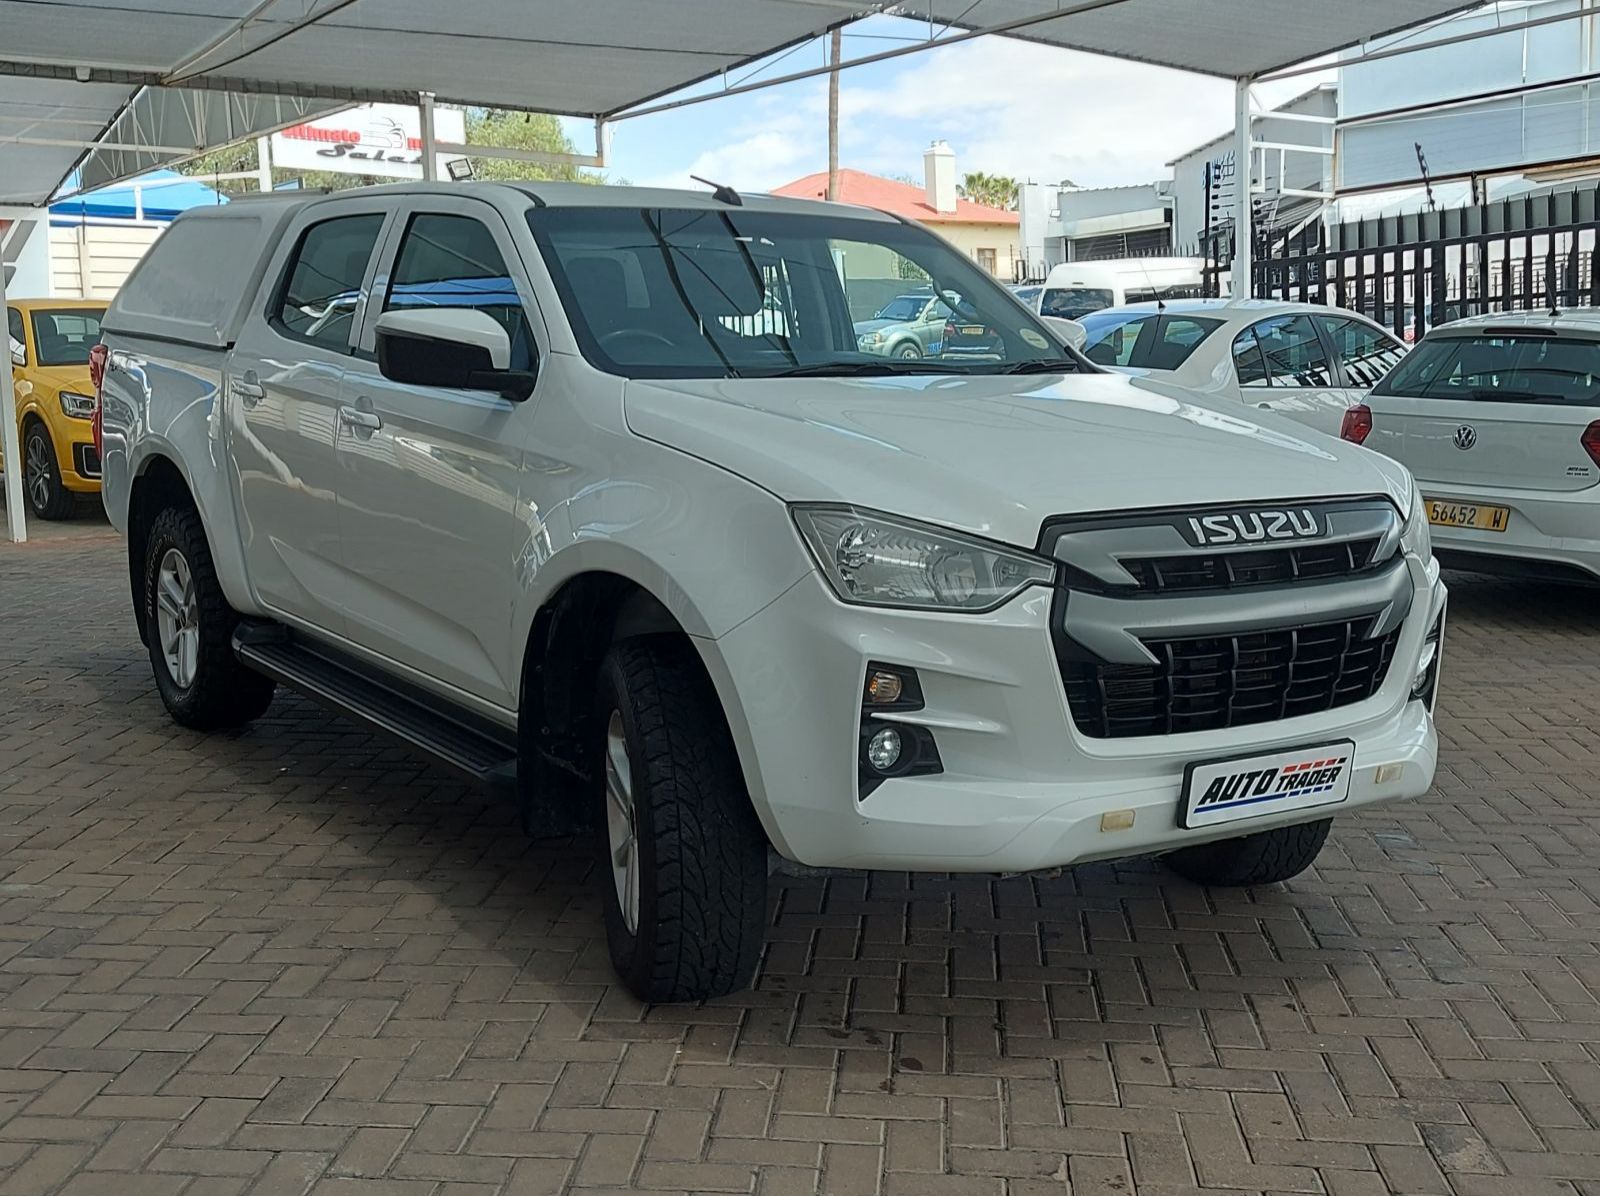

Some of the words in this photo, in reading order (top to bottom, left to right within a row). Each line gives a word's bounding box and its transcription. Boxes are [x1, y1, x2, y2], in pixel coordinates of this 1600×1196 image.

[1188, 509, 1318, 544] ISUZU
[1431, 504, 1477, 526] 56452
[1197, 768, 1280, 806] AUTO
[1275, 766, 1343, 793] TRADER
